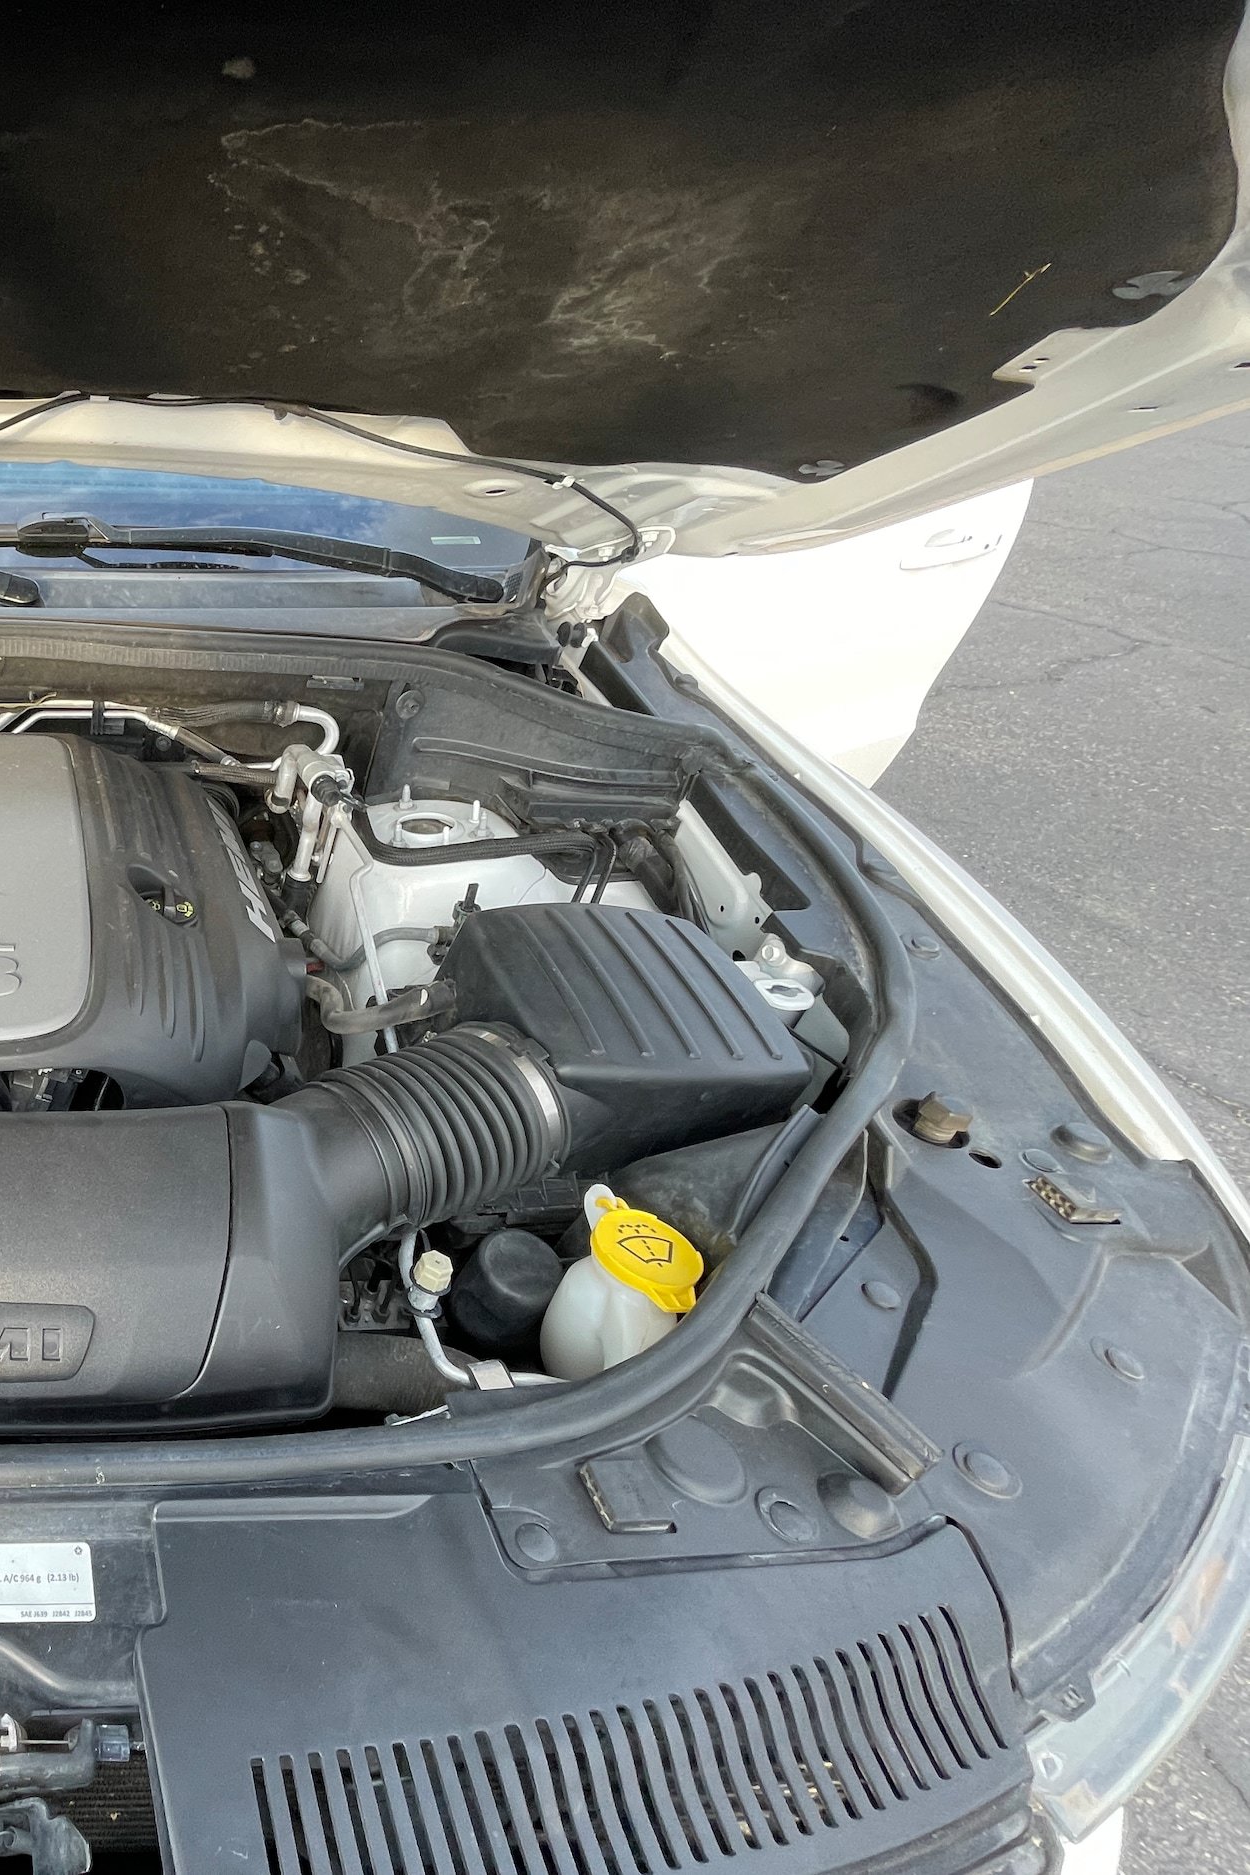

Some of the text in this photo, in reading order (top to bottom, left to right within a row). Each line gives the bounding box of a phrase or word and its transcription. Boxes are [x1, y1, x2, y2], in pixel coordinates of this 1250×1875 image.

[3, 1573, 19, 1584] A/C
[19, 1573, 35, 1583] 964
[47, 1573, 68, 1583] (2.13
